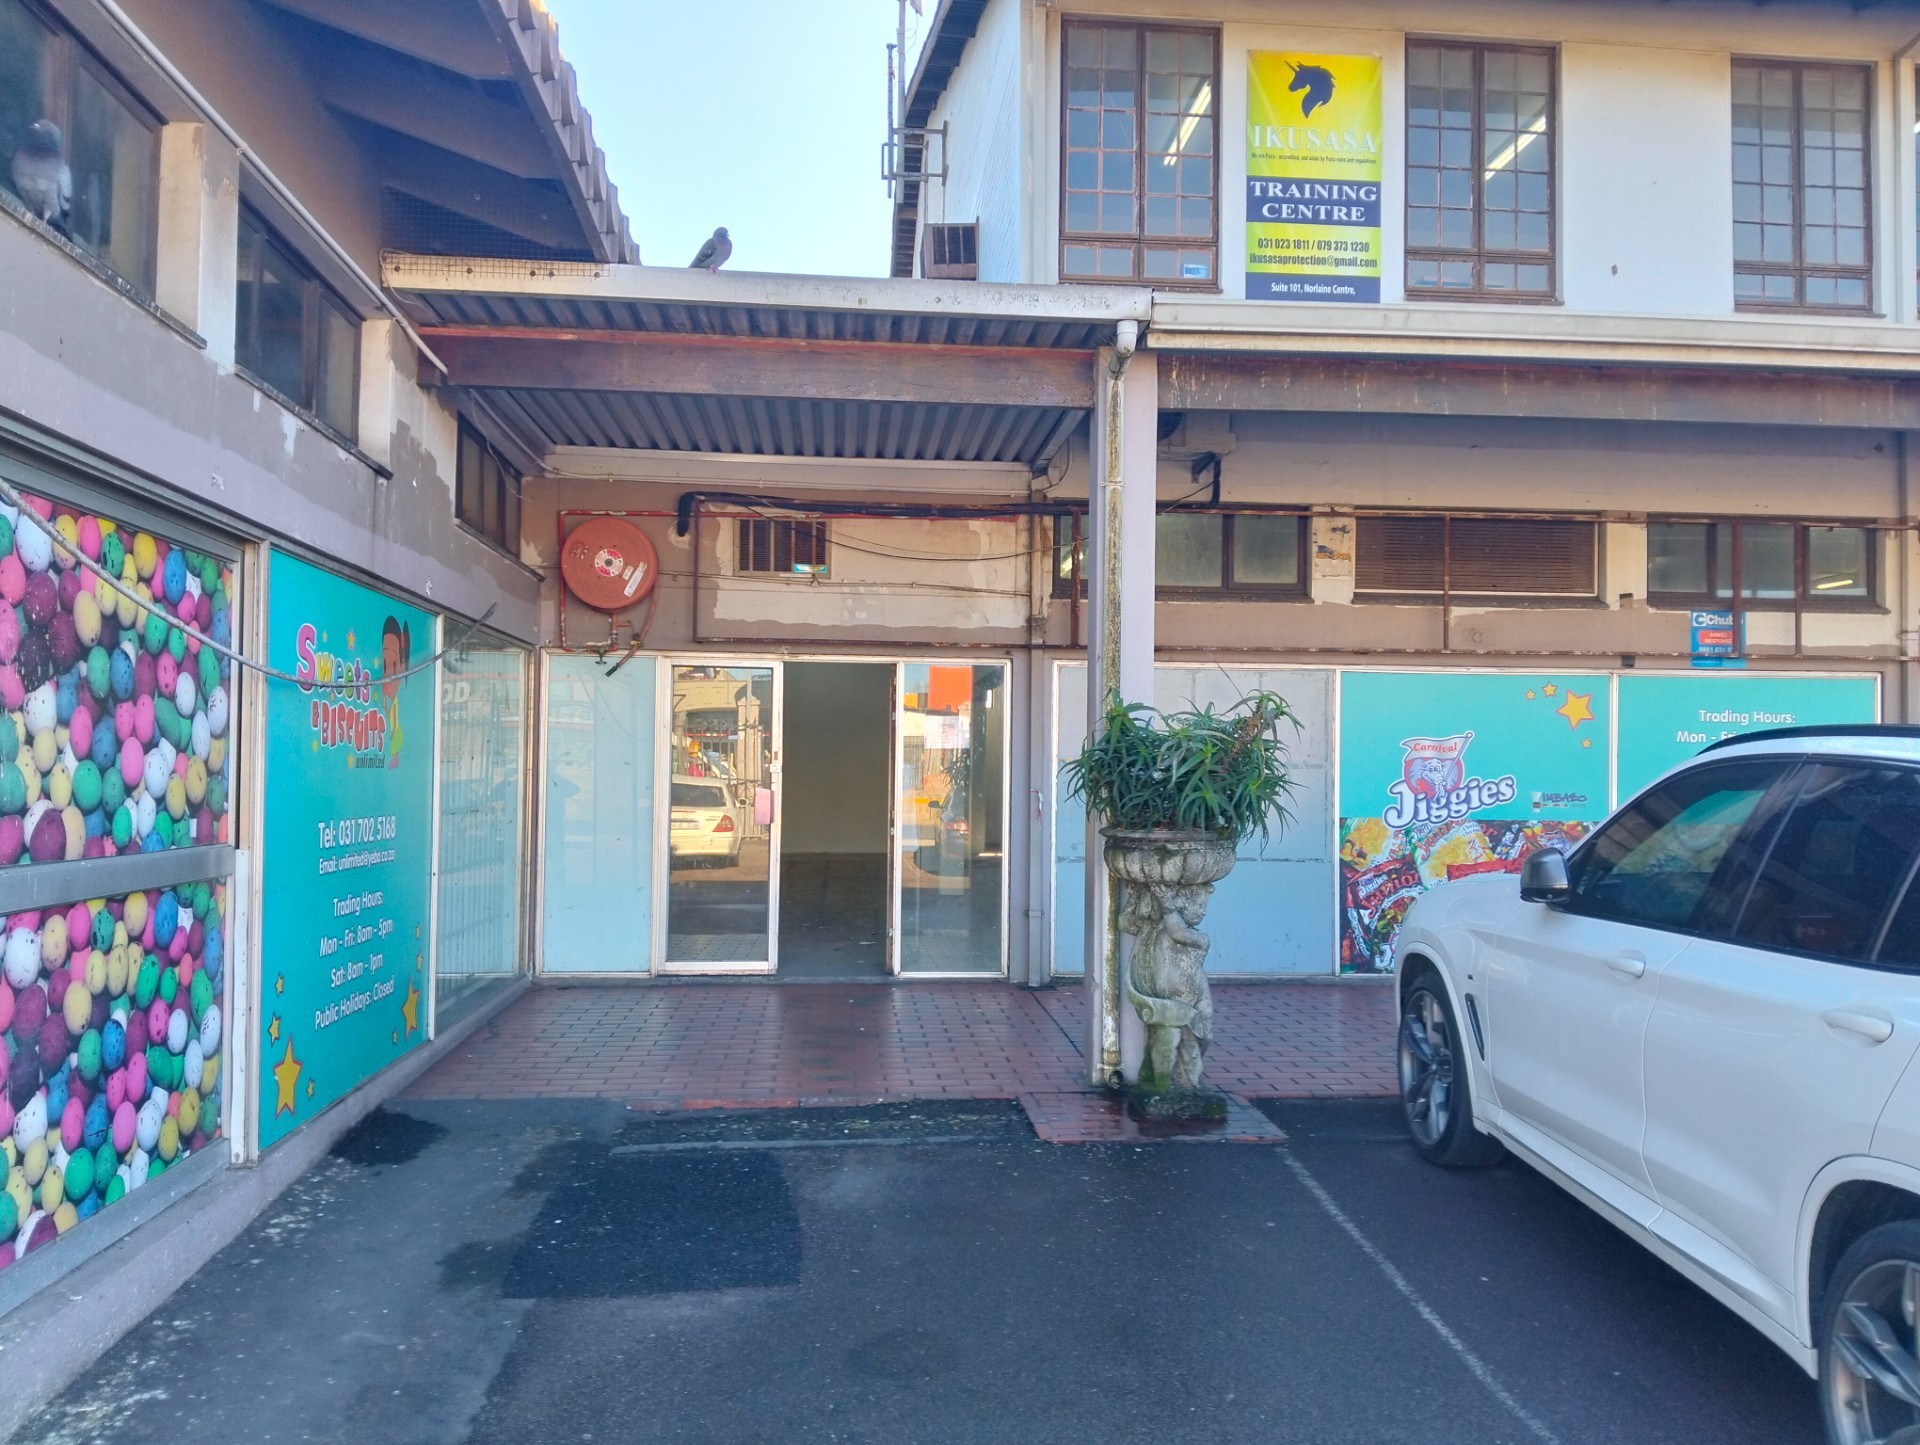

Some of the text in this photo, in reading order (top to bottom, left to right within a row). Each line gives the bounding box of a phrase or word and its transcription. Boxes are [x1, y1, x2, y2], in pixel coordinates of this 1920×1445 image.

[1253, 125, 1376, 153] IKUSASA
[1250, 181, 1377, 201] TRAINING
[1262, 202, 1365, 222] CENTRE
[1258, 238, 1274, 249] 031
[1274, 238, 1290, 250] 023
[1292, 239, 1310, 250] 1811
[1317, 240, 1333, 251] 079
[1334, 241, 1349, 252] 373
[1350, 242, 1370, 253] 1230
[1250, 252, 1377, 269] ikusasaprotection@gmail.com
[1271, 282, 1356, 295] Suite 101, Norlaine Centre,
[296, 623, 371, 705] Sweets
[321, 700, 386, 753] BISCUITS
[1699, 710, 1796, 725] Trading Hours:
[1676, 731, 1706, 743] Mon
[1412, 741, 1458, 754] Carnival
[356, 754, 385, 769] unlimited
[1383, 774, 1517, 829] Jiggies
[318, 816, 396, 849] Tel: 031 702 5168
[319, 855, 338, 875] Email:
[333, 890, 383, 919] Trading Hours:
[320, 935, 337, 957] Mon
[345, 928, 355, 948] Fri:
[357, 924, 373, 943] 8am
[378, 918, 393, 940] 5pm
[331, 968, 346, 988] Sat:
[347, 961, 363, 981] 8am
[370, 953, 383, 975] 1pm
[315, 976, 394, 1030] Public Holidays: Closed
